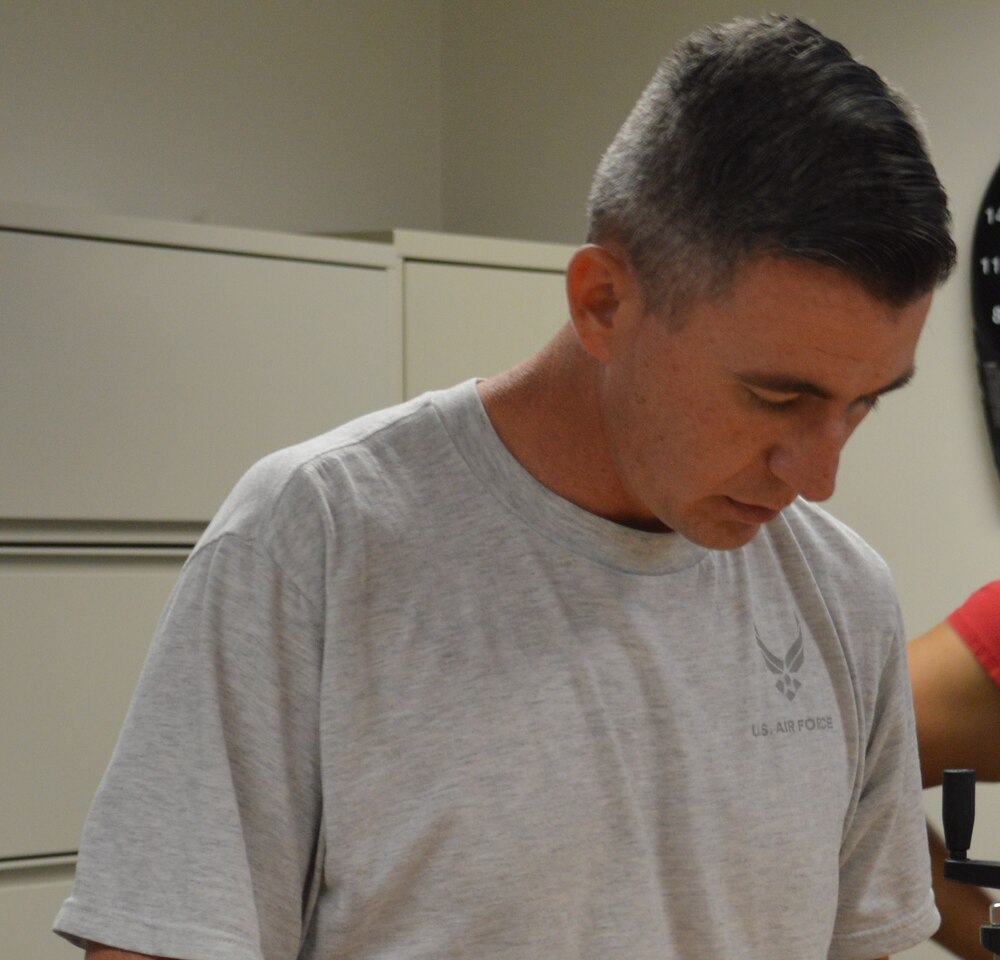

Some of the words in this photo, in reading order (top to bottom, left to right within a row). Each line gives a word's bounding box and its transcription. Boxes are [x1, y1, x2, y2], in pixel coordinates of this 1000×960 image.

[982, 258, 1000, 274] 11
[752, 724, 773, 737] U.S.
[776, 720, 796, 734] AIR
[798, 716, 833, 732] FORCE
